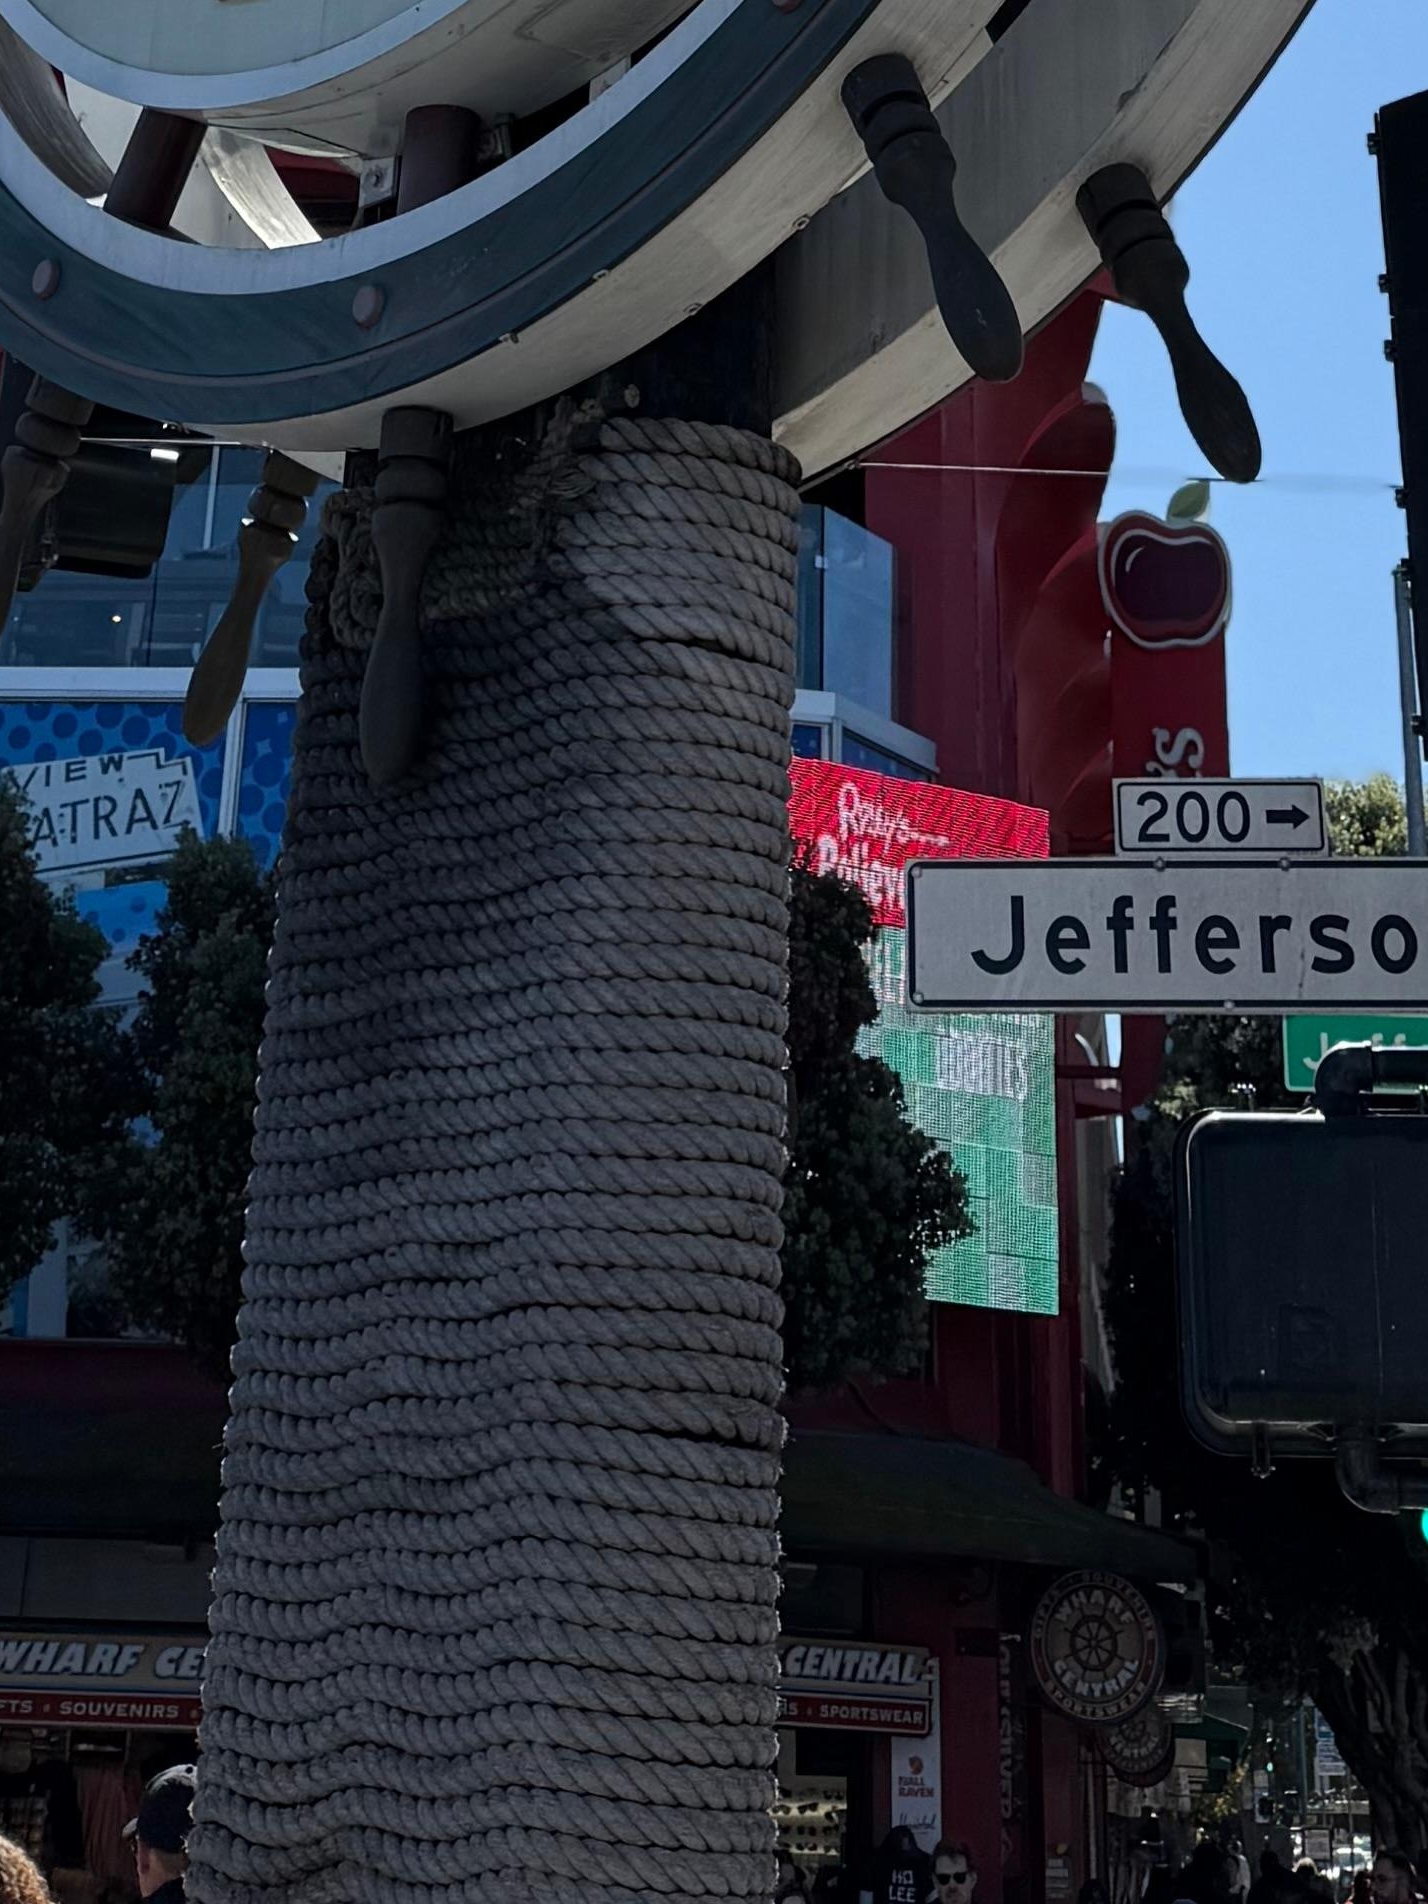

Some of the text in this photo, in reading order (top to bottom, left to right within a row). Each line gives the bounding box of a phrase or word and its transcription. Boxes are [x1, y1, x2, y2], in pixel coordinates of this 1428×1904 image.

[8, 754, 123, 792] VIEW
[31, 780, 191, 852] ATRAZ
[1137, 790, 1250, 843] 200
[784, 1645, 922, 1685] CENTRAL
[1053, 1659, 1139, 1697] CENTRAL
[59, 1700, 180, 1719] SOUVENIRS
[820, 1704, 924, 1725] SPORTSWEAR
